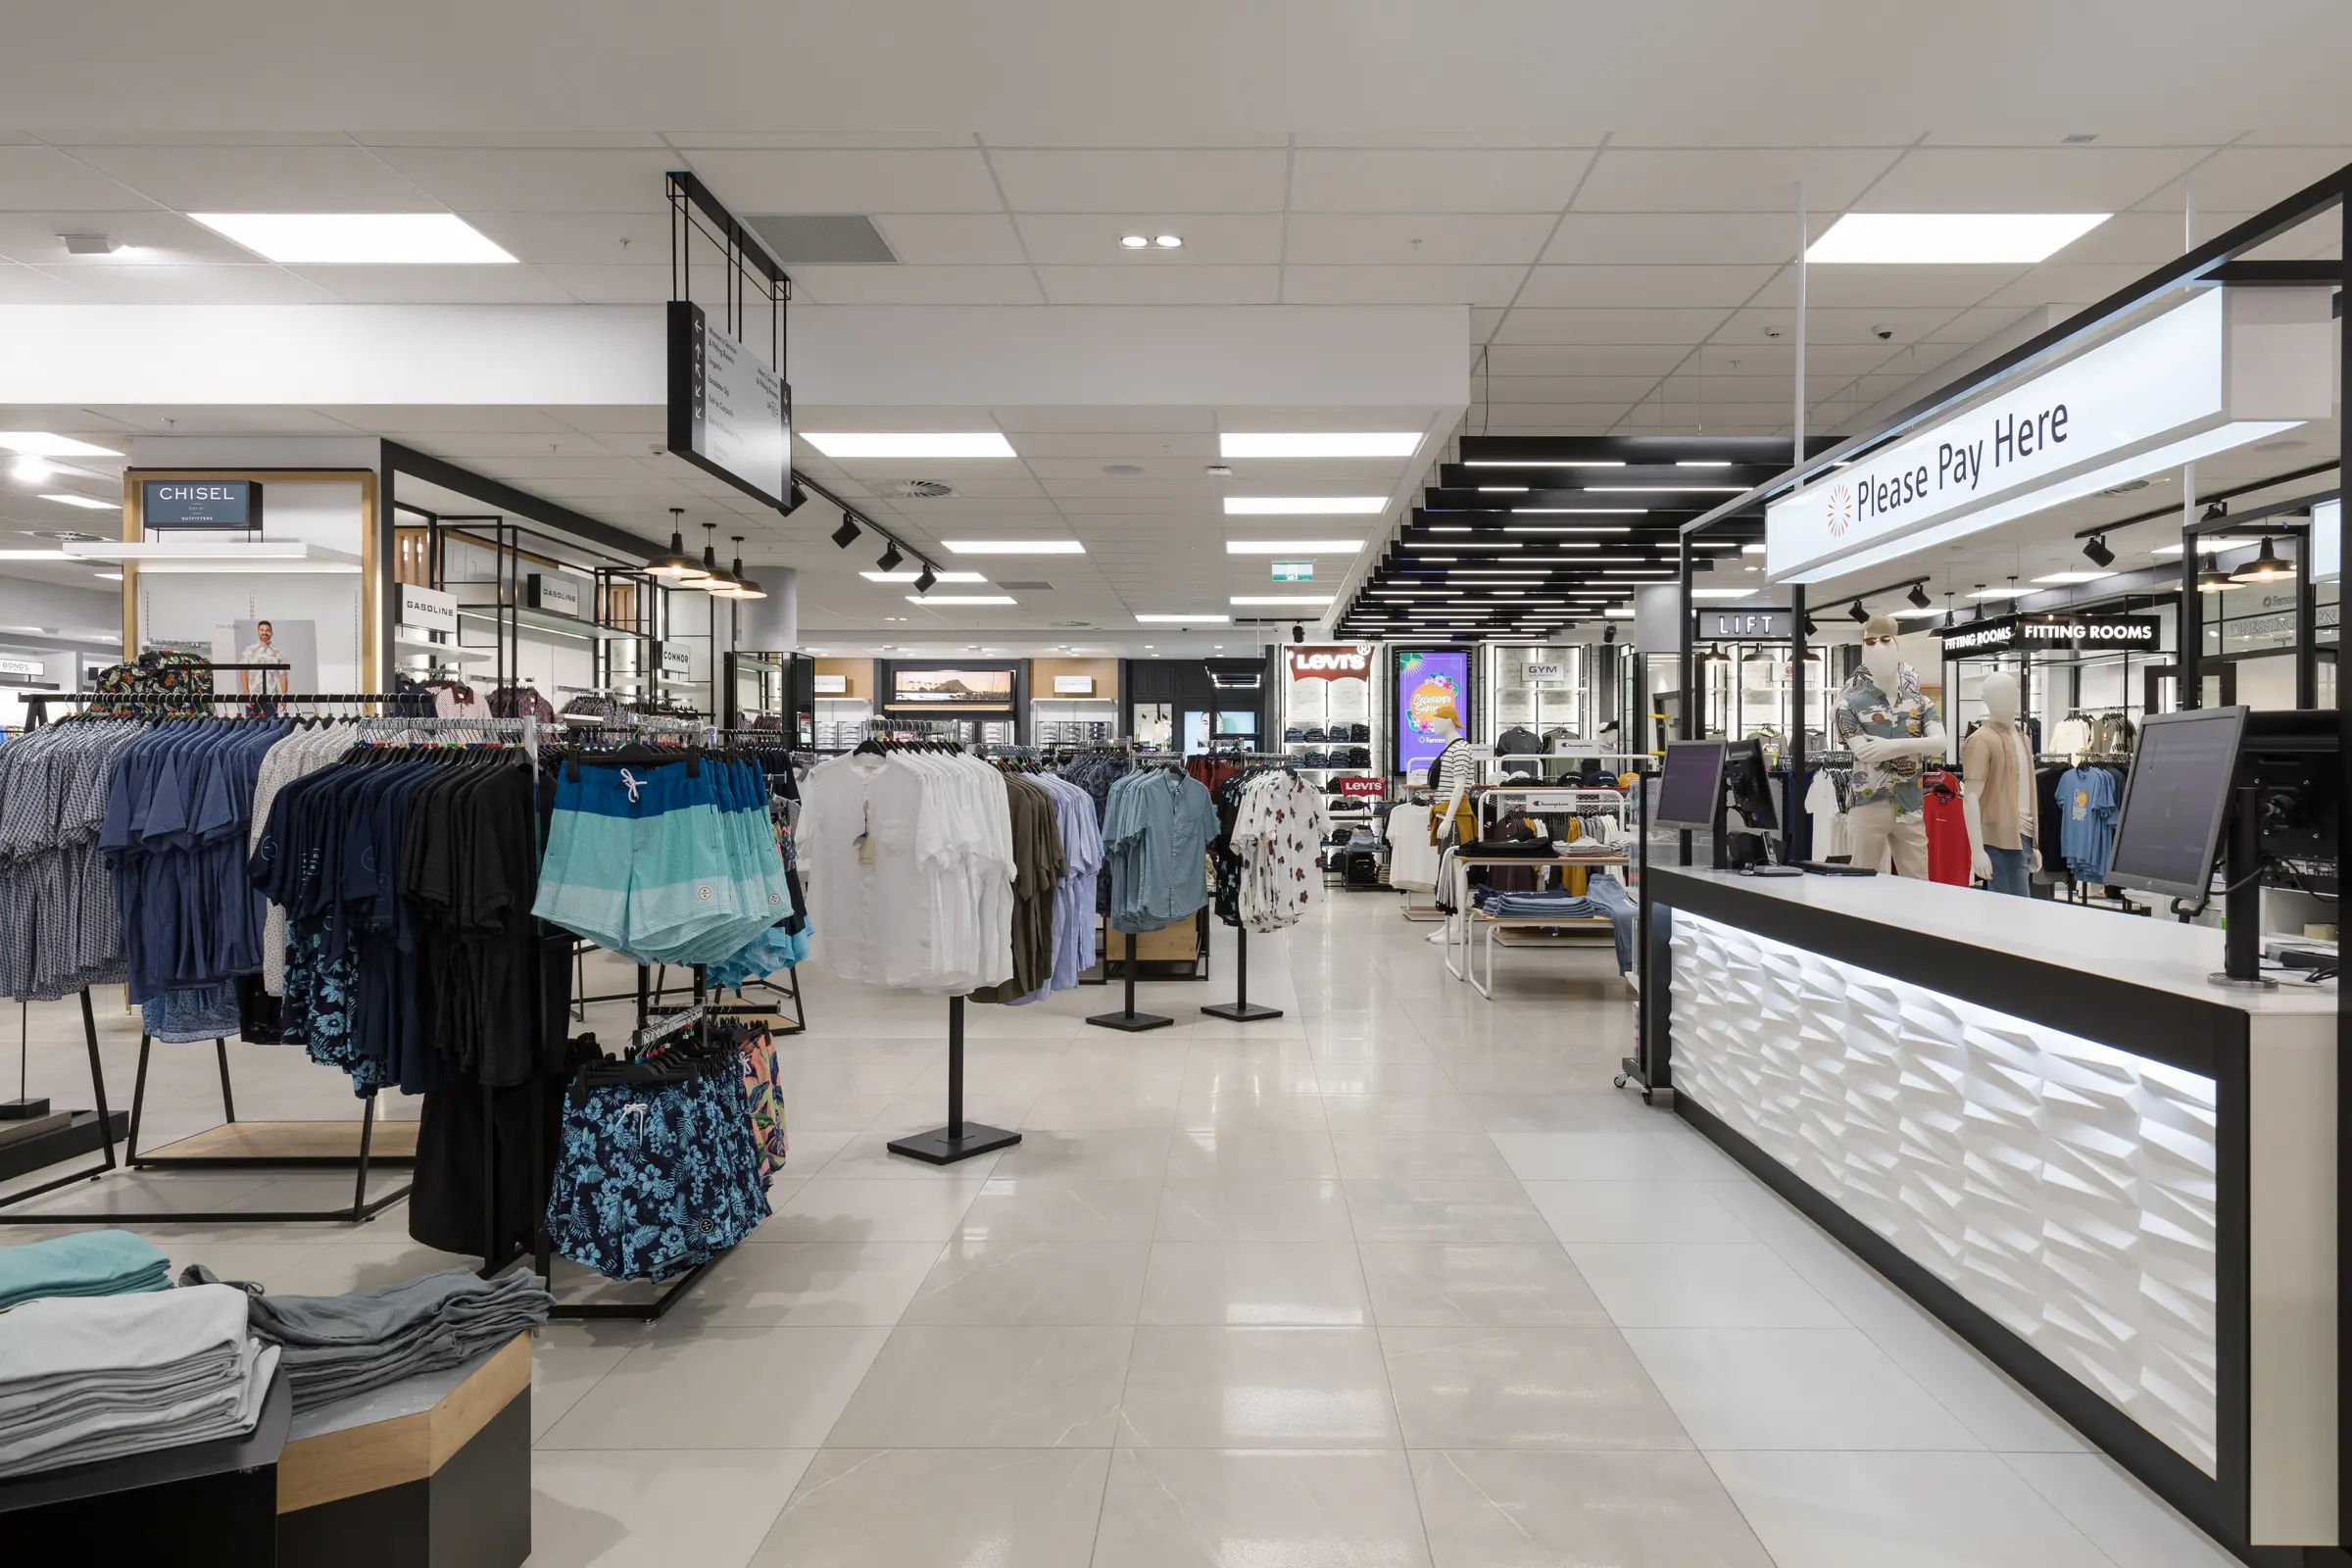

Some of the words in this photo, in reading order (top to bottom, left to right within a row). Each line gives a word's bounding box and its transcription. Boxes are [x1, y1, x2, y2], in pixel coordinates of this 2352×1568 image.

[1858, 466, 1929, 522] Please
[1939, 439, 1984, 490] Pay
[1995, 404, 2068, 468] Here
[160, 487, 235, 500] CHISEL
[543, 588, 576, 603] GASOLINE
[407, 600, 454, 617] GASOLINE
[1719, 611, 1773, 634] LIFT
[1945, 633, 1977, 650] FITTING
[1977, 626, 2011, 645] ROOMS
[2025, 624, 2086, 639] FITTING
[2089, 625, 2152, 639] ROOMS
[663, 651, 689, 663] CONNOR
